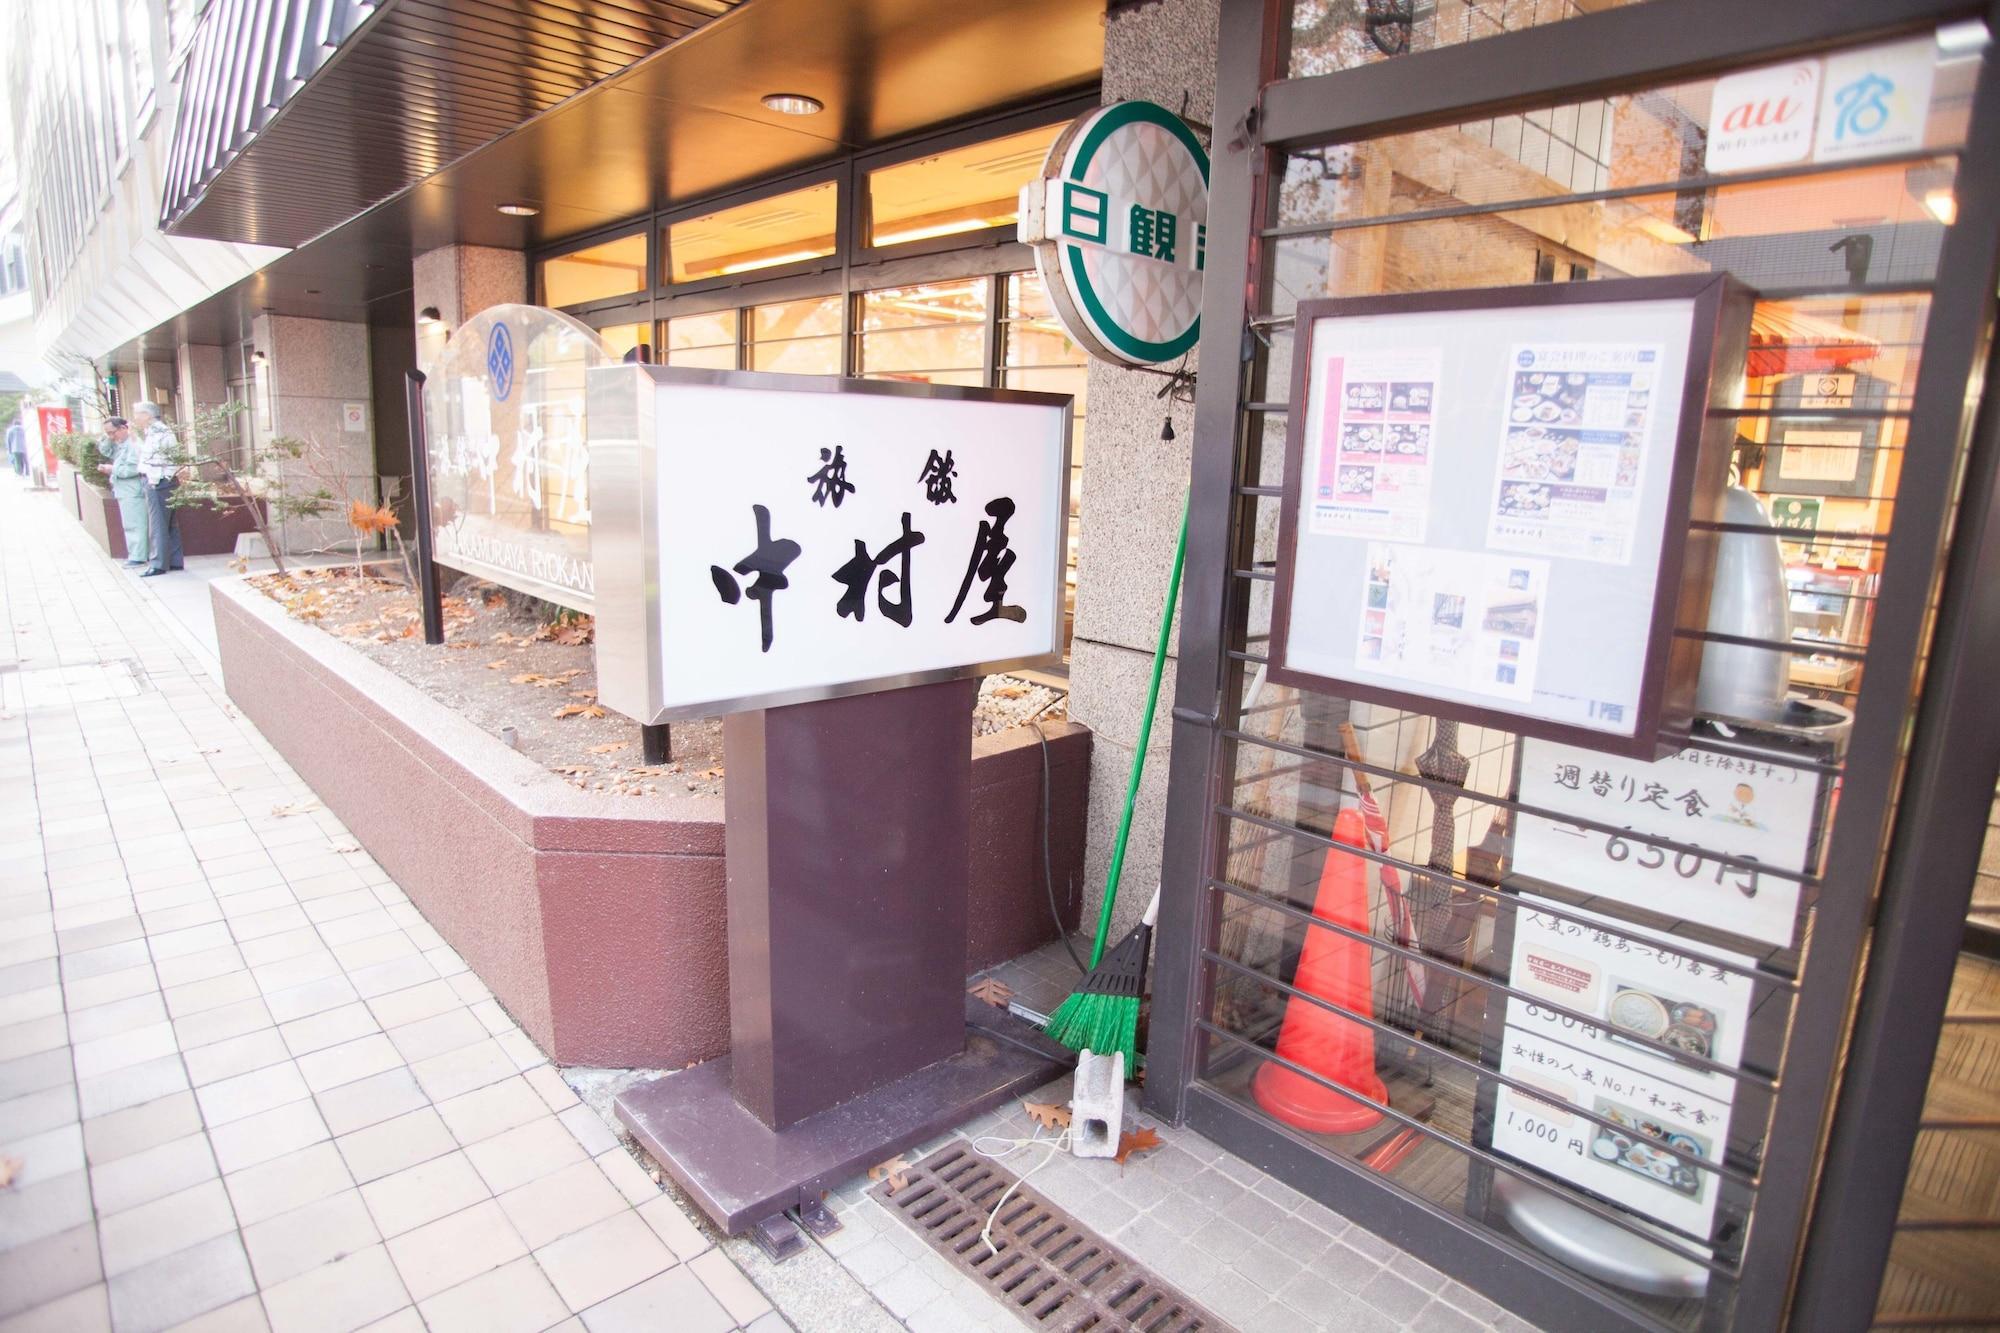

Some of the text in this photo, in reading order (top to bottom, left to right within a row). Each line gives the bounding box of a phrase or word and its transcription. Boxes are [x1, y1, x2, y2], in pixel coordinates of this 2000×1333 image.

[1722, 96, 1801, 133] au
[530, 547, 595, 593] RYOKAN
[710, 496, 1027, 653] 中村屋
[1554, 763, 1709, 817] 週替り定食
